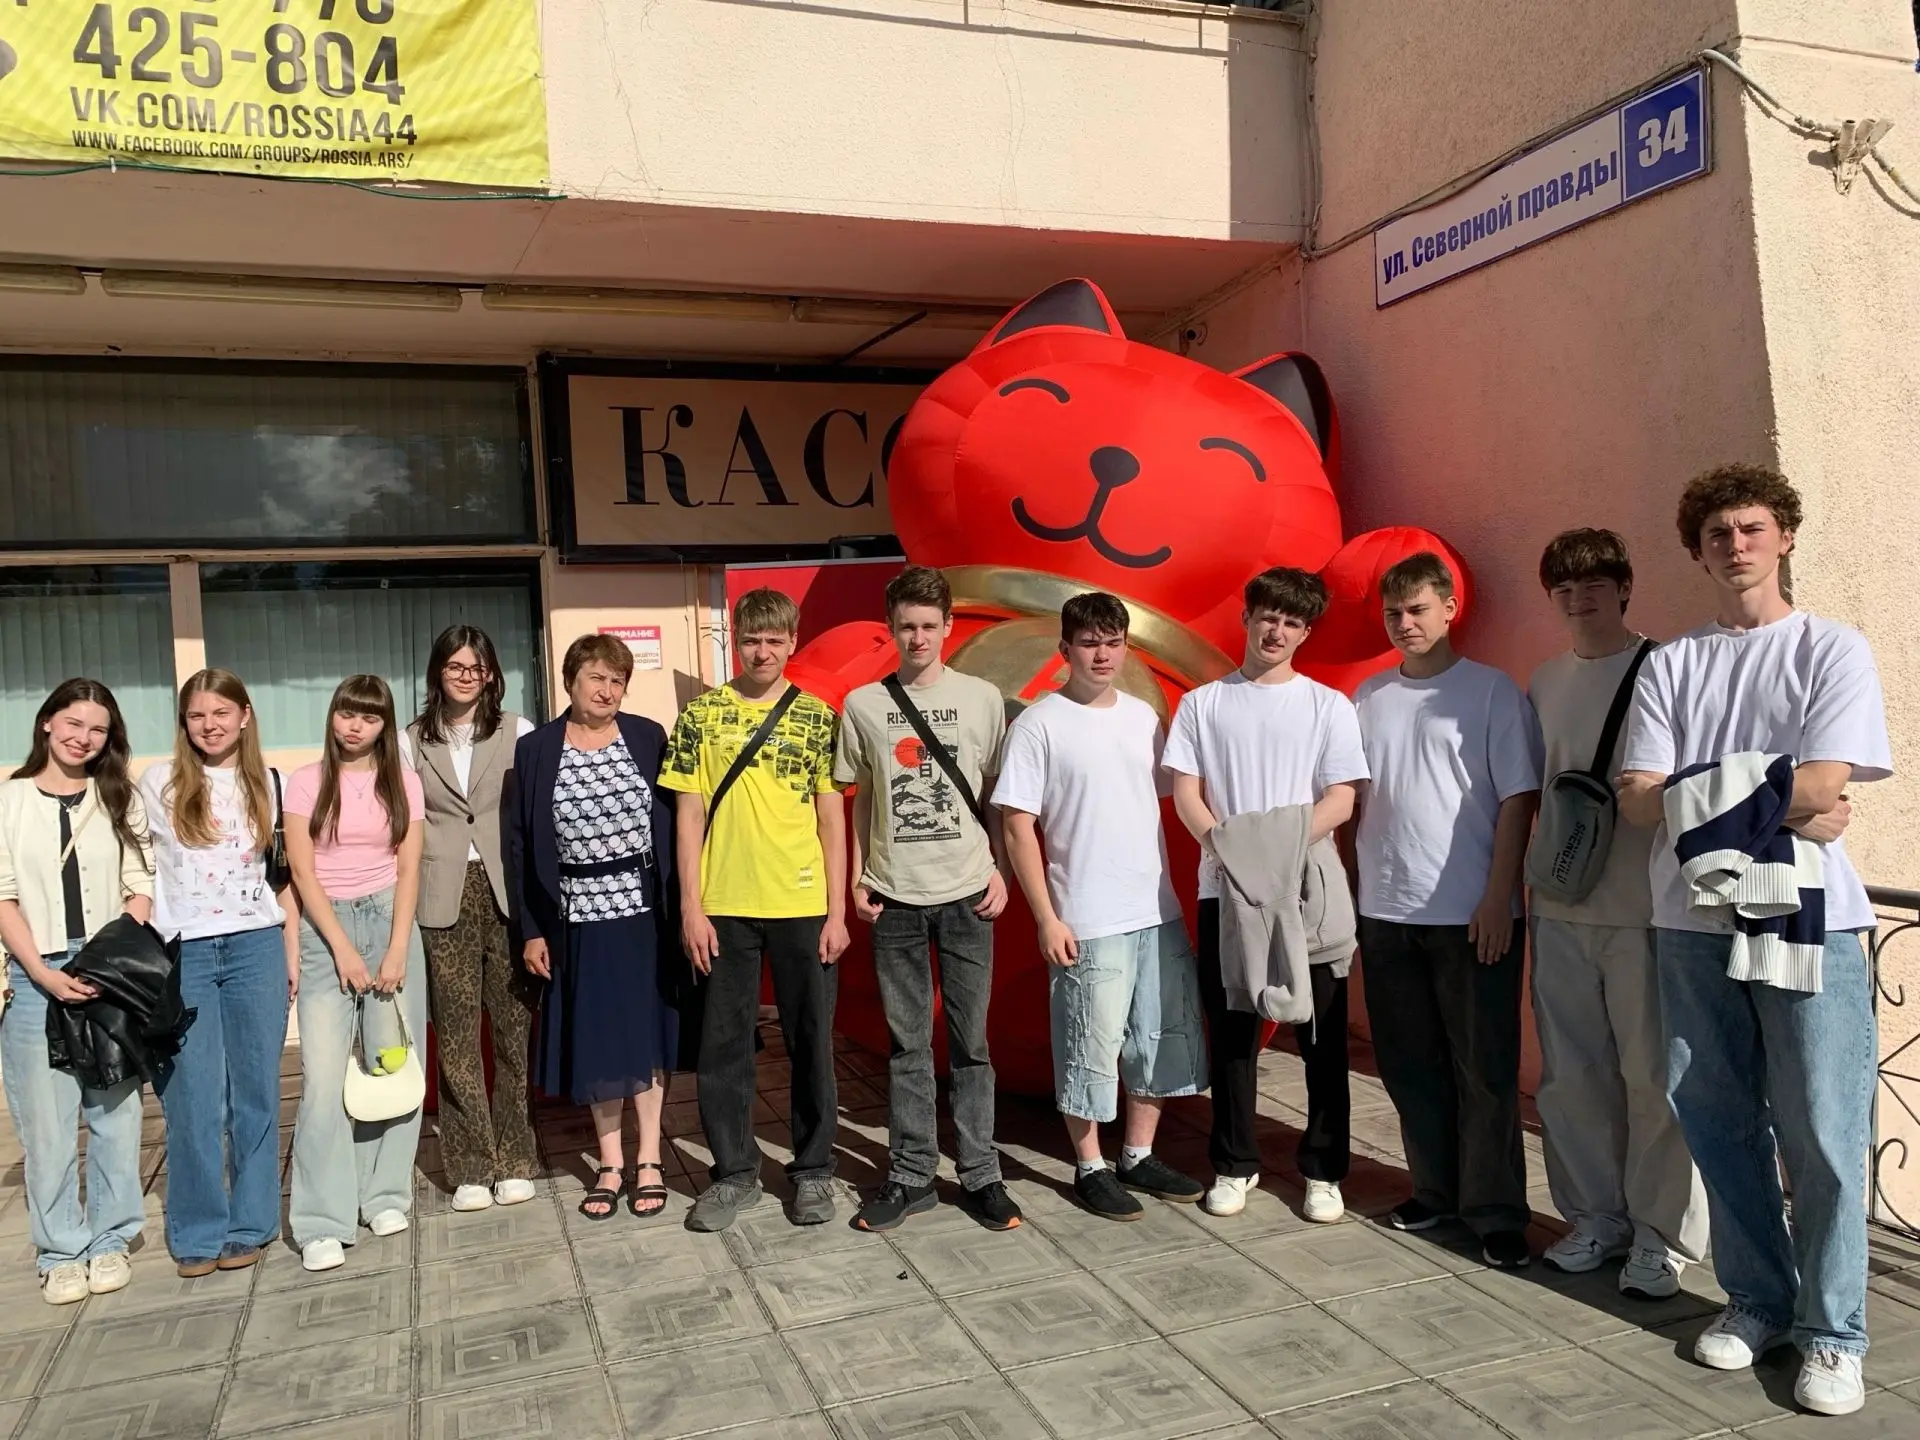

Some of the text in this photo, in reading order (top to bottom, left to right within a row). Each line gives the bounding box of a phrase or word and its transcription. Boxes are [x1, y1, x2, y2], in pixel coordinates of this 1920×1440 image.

[73, 3, 406, 106] 425-804
[70, 86, 418, 146] VK.COM/ROSSIA44
[1638, 105, 1689, 168] 34
[72, 130, 415, 168] WWW.FACEBOOK.COM/GROUPS/ROSSIA.ARS/
[1383, 150, 1618, 284] ул. Северной правды
[887, 708, 958, 724] RISG SUN
